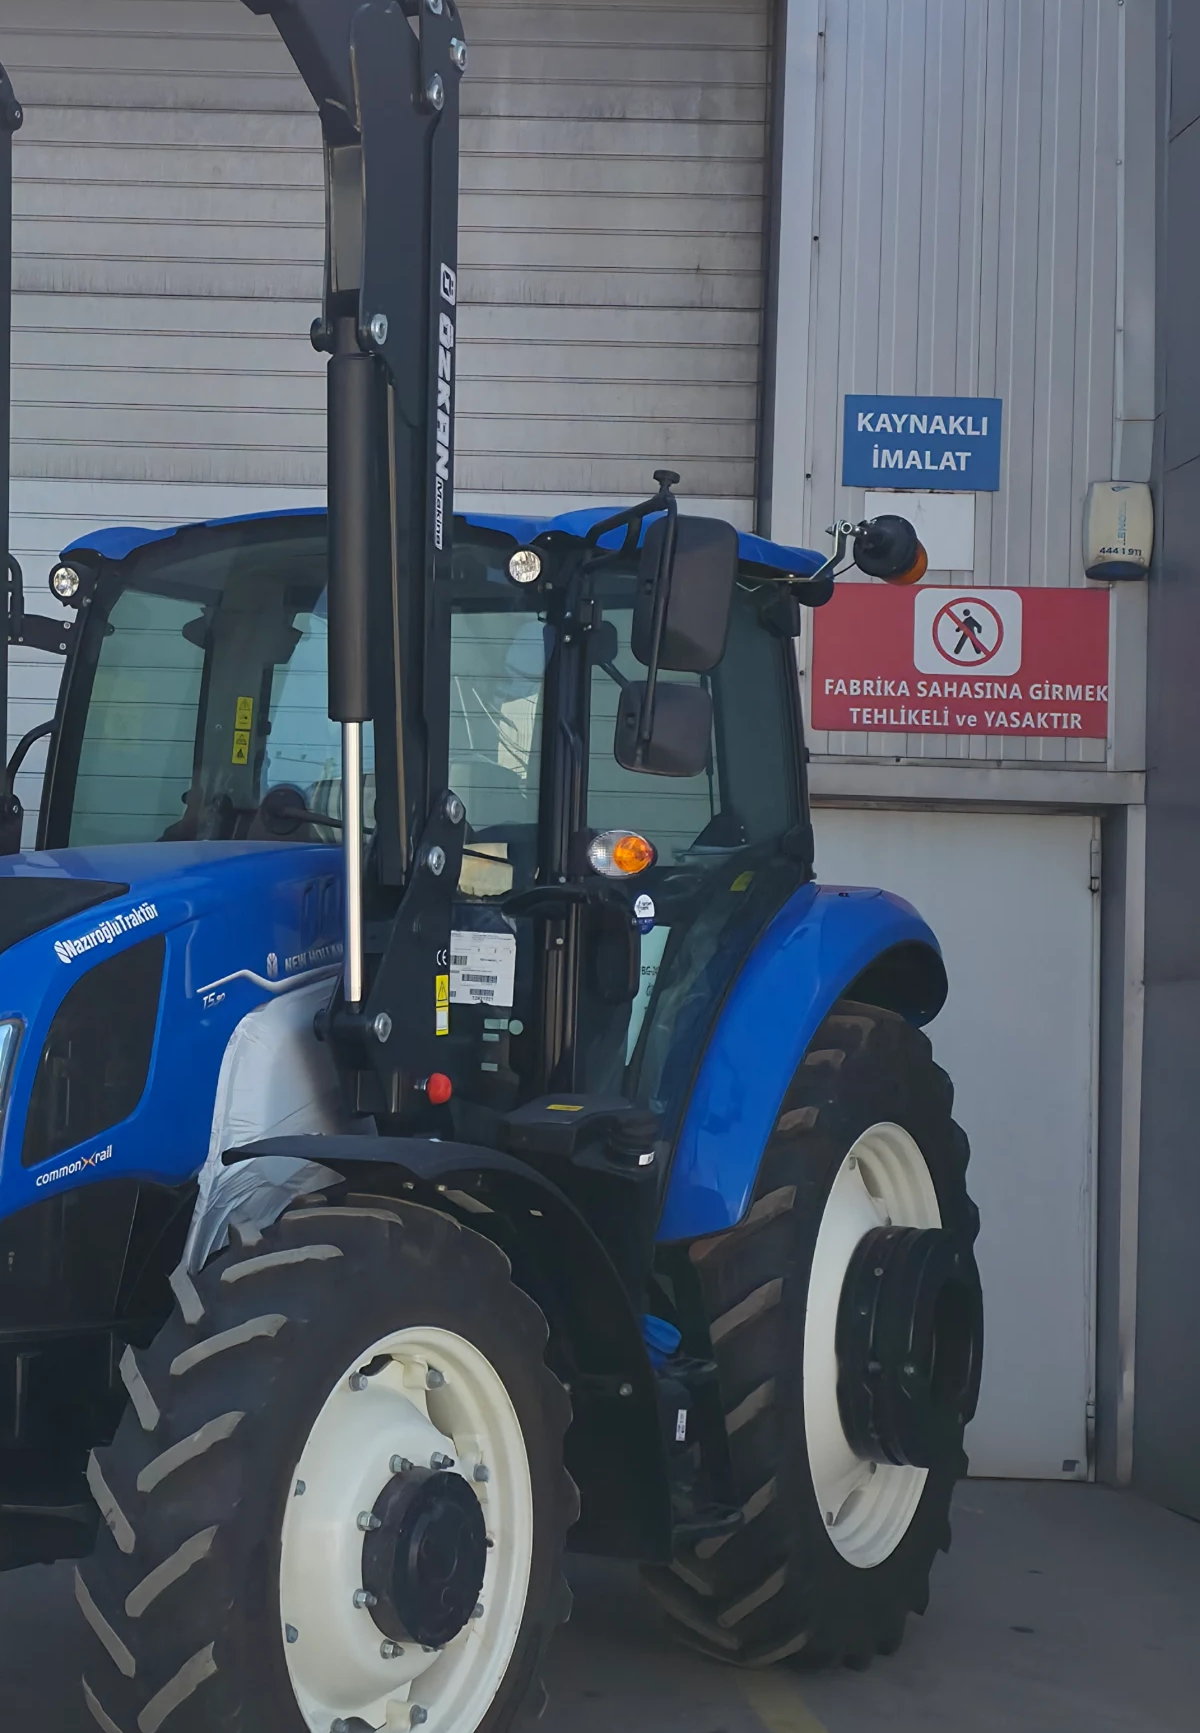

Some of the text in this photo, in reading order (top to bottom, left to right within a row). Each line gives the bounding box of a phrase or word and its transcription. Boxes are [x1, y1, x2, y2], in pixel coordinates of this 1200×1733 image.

[857, 412, 988, 436] KAYNAKLI
[872, 443, 972, 471] İMALAT
[824, 676, 1109, 702] FABRİKA SAHASINA GİRMEK
[849, 705, 1083, 730] TEHLİKELİ ve YASAKTIR
